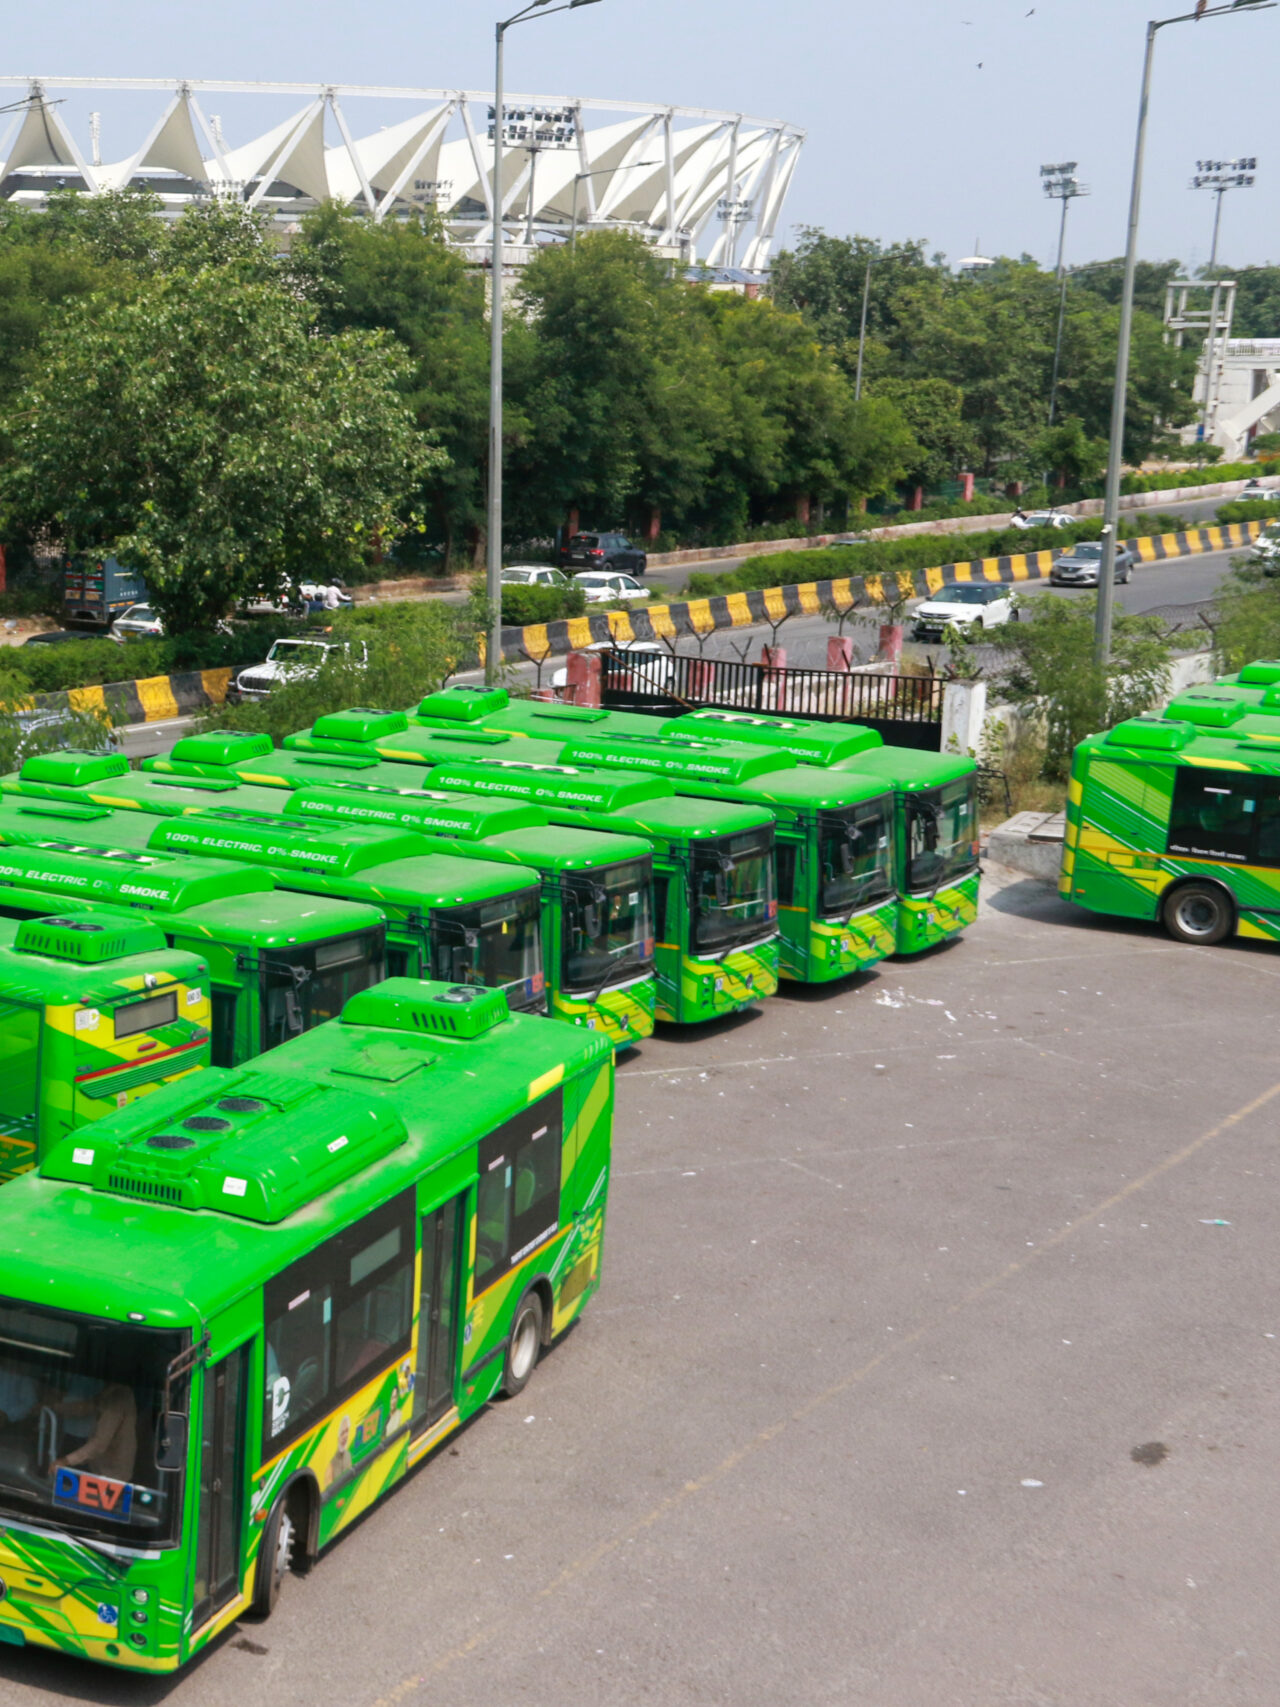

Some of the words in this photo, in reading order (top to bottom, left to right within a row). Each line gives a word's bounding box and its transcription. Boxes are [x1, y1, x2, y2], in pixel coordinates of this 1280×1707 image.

[572, 751, 603, 760] 100%
[605, 754, 662, 767] ELECTRIC.
[665, 761, 684, 769] 0%
[686, 763, 732, 775] SMOKE.
[439, 776, 471, 786] 100%
[474, 781, 531, 794] ELECTRIC.
[535, 788, 555, 797] 0%
[557, 791, 604, 803] SMOKE.
[301, 801, 334, 812] 100%
[336, 806, 397, 820] ELECTRIC.
[401, 814, 420, 823] 0%
[424, 817, 472, 831] SMOKE.
[165, 832, 199, 844] 100%
[202, 837, 263, 853] ELECTRIC.
[267, 846, 287, 856] 0%
[290, 849, 340, 864] SMOKE.
[25, 870, 89, 887] ELECTRIC.
[120, 884, 171, 900] SMOKE.
[55, 1468, 133, 1513] DEVi
